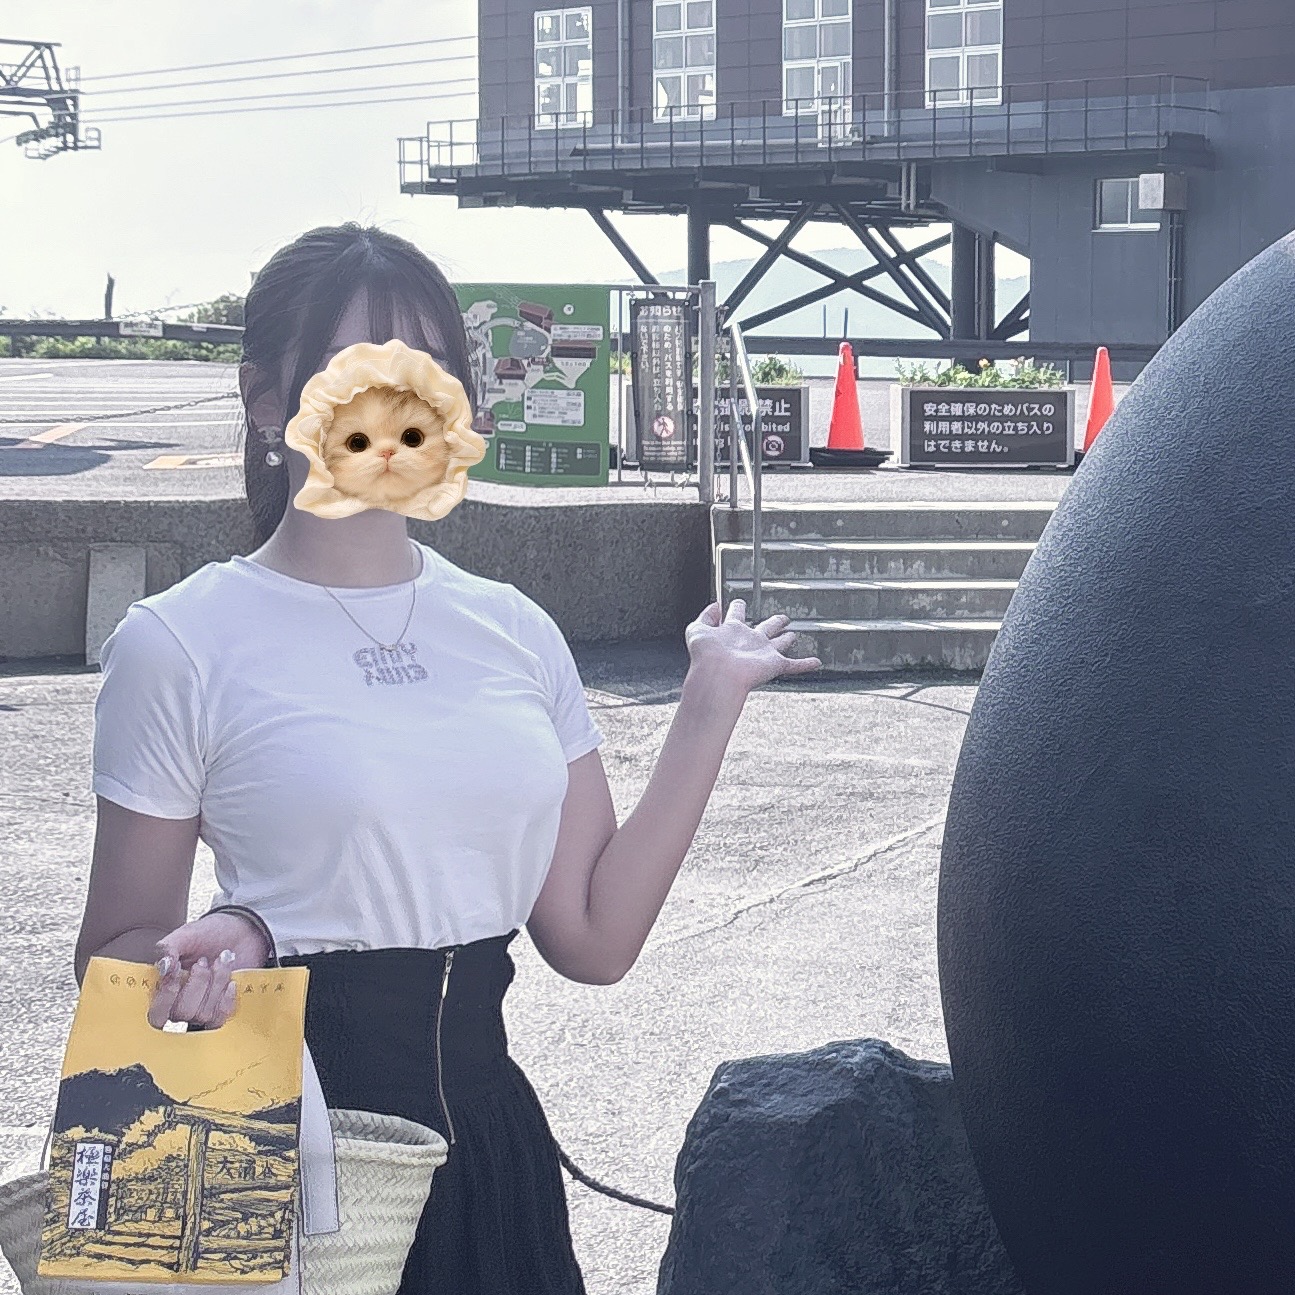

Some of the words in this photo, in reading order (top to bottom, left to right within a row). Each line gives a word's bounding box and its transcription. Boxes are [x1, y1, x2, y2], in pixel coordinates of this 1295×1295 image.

[924, 402, 1055, 416] 安全確保のためバスの
[923, 420, 1053, 435] 利用者以外の立ち入り
[924, 439, 1009, 453] はできません。
